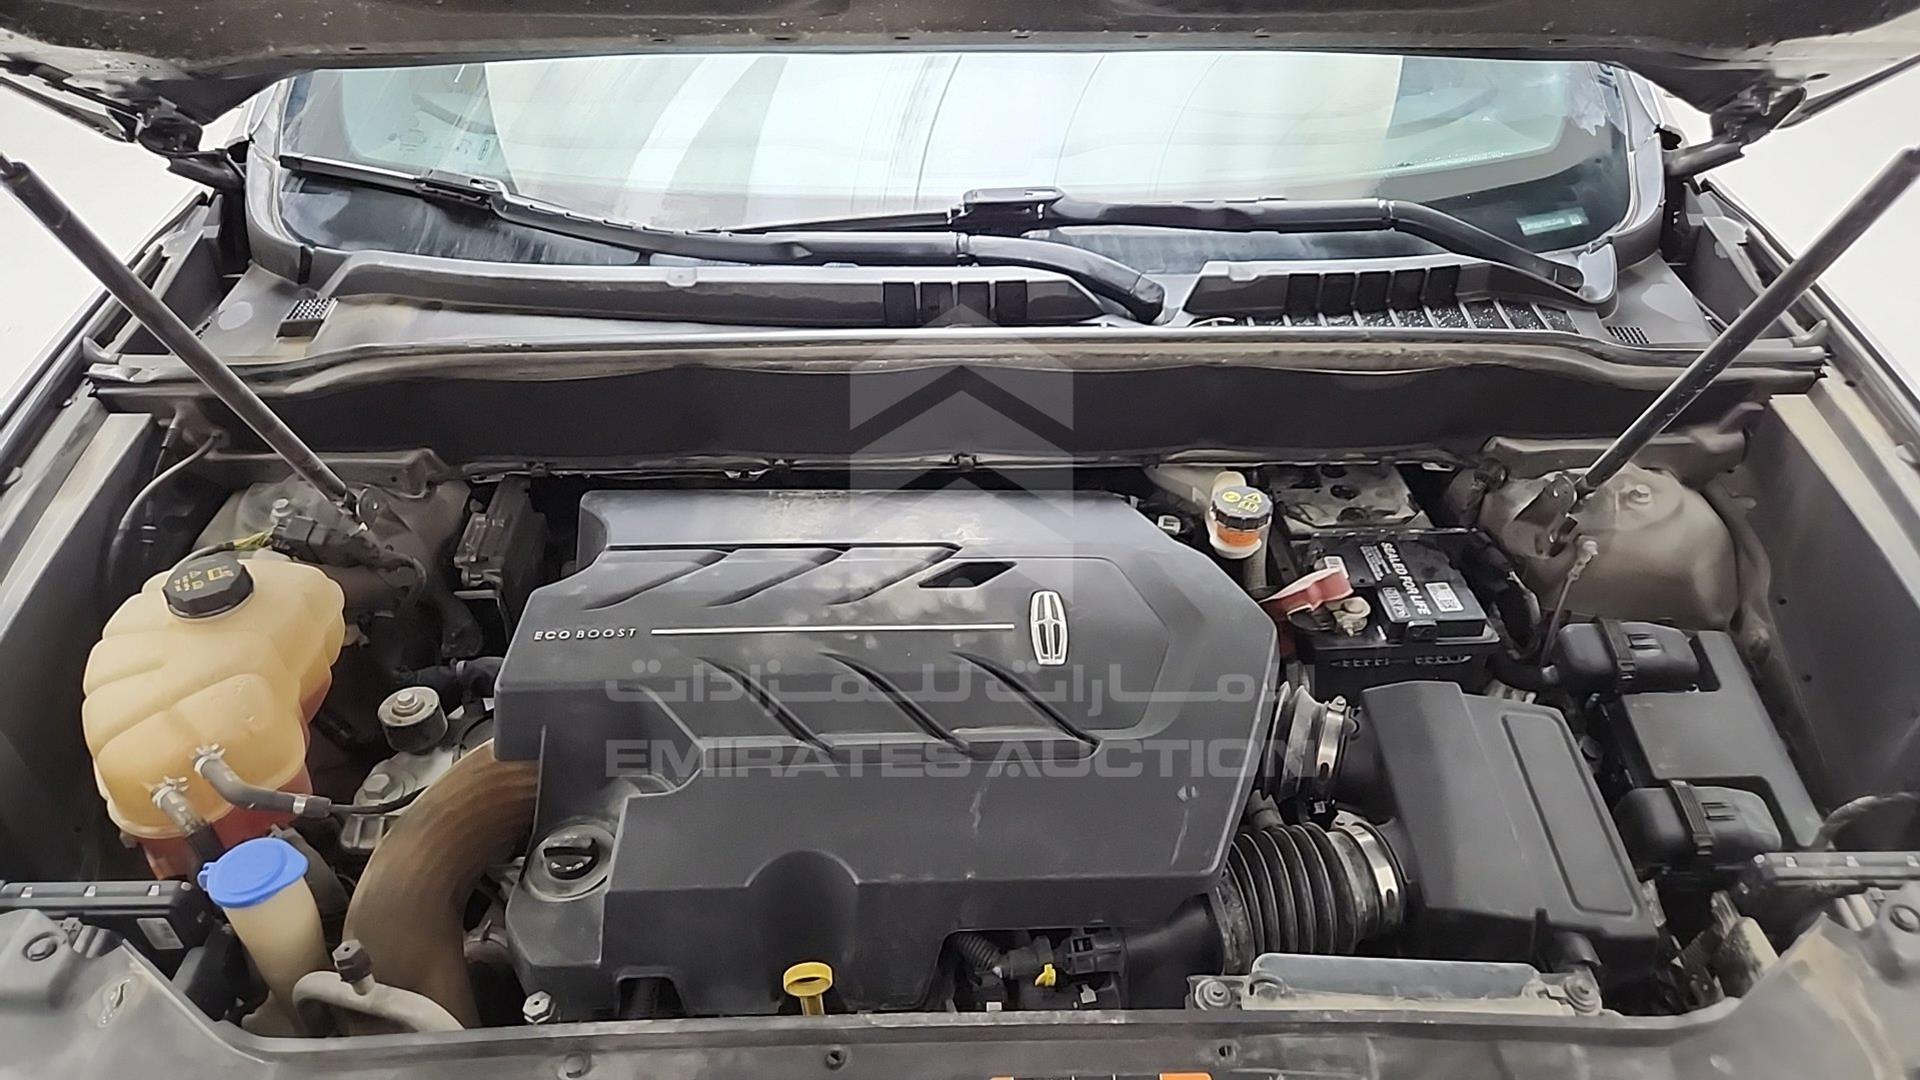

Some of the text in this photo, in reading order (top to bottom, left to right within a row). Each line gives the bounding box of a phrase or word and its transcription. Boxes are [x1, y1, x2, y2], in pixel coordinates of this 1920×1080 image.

[1382, 542, 1408, 575] SEALED
[1399, 576, 1420, 595] FOR
[1410, 595, 1432, 615] LIFE
